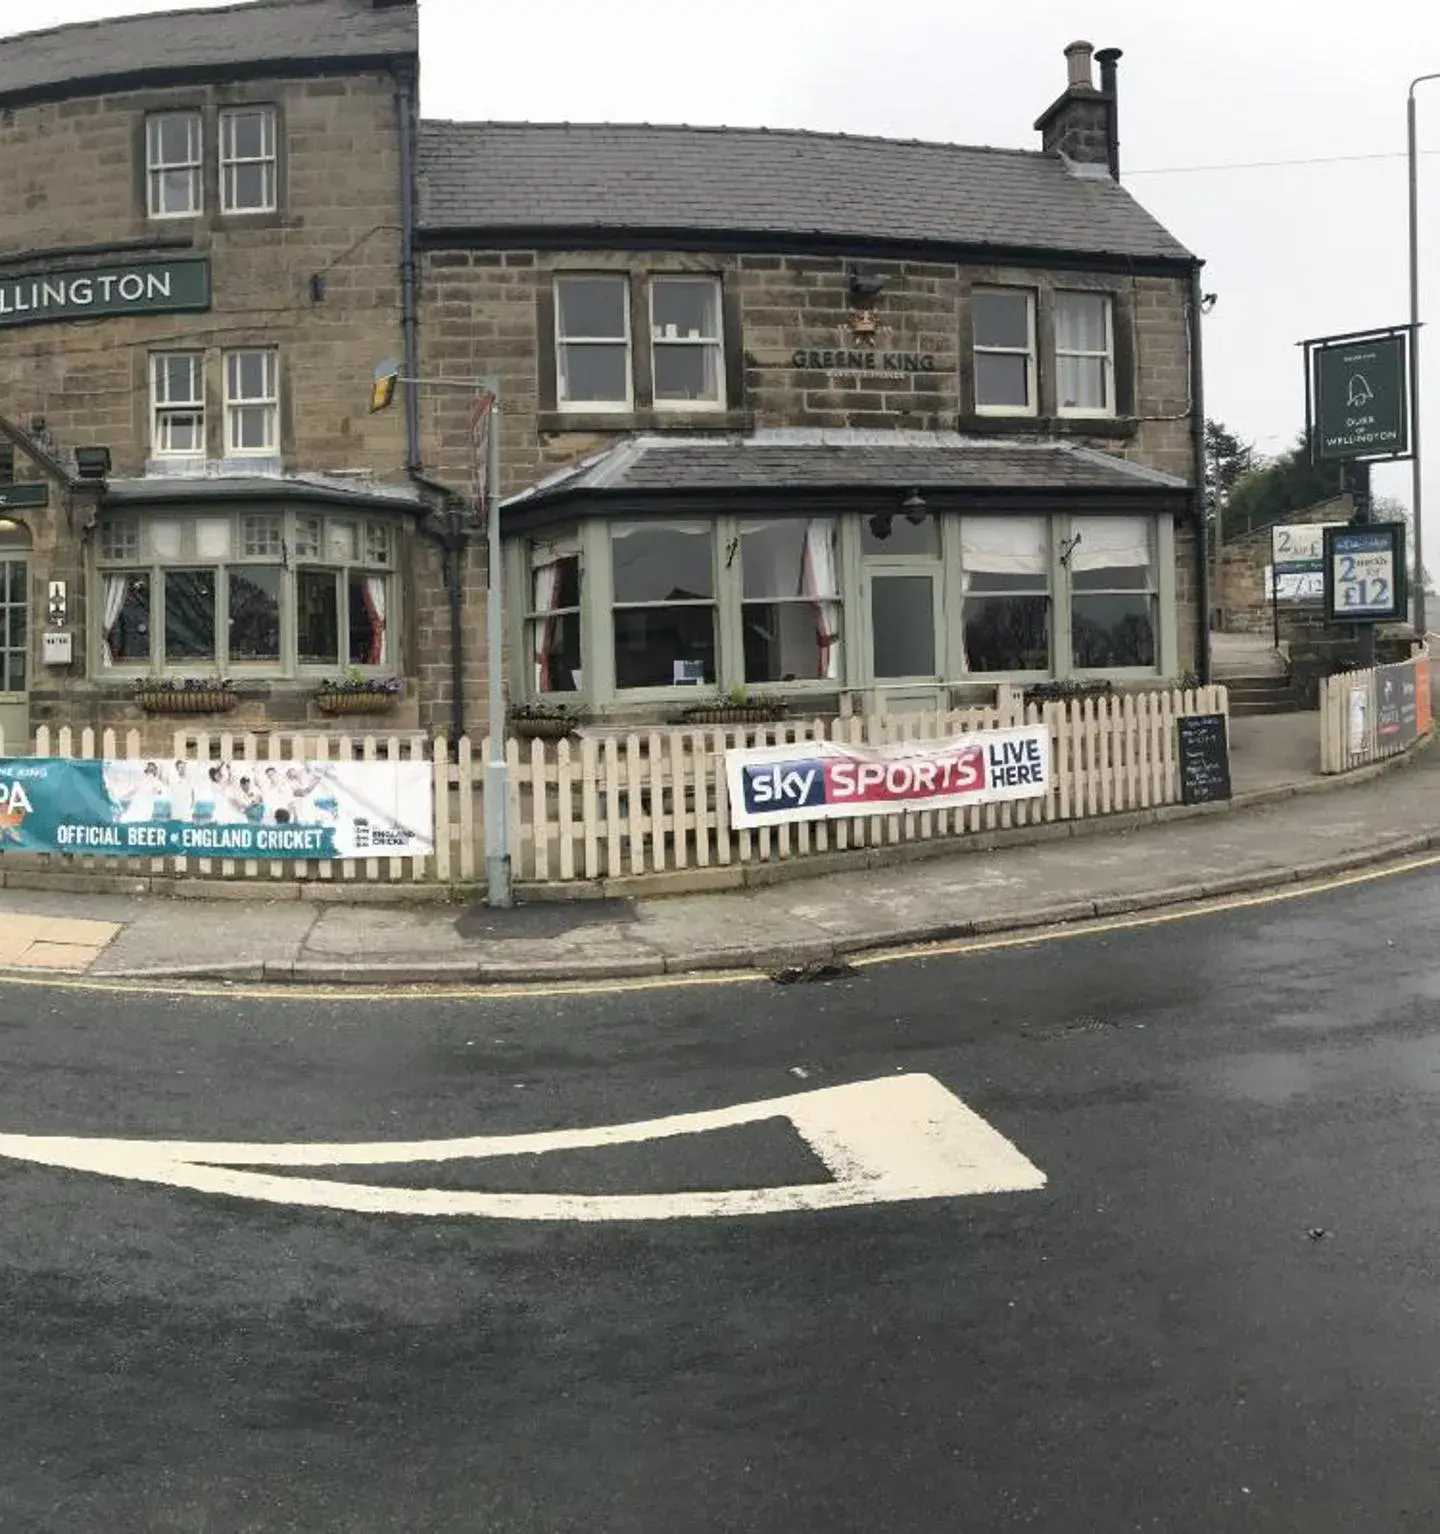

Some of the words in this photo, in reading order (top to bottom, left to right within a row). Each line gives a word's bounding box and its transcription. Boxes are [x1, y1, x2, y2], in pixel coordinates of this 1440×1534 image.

[791, 350, 876, 370] GREENE
[882, 352, 935, 371] KING
[1346, 415, 1374, 427] DUKE
[1326, 431, 1397, 446] WELLINGTON
[1339, 556, 1357, 582] 2
[1344, 577, 1390, 606] £12
[989, 738, 1041, 766] LIVE
[753, 765, 815, 805] sky
[830, 755, 978, 797] SPORTS
[991, 762, 1044, 788] HERE
[57, 825, 122, 846] OFFICIAL
[128, 827, 166, 845] BEER
[182, 829, 252, 848] ENGLAND
[257, 829, 322, 850] CRICKET
